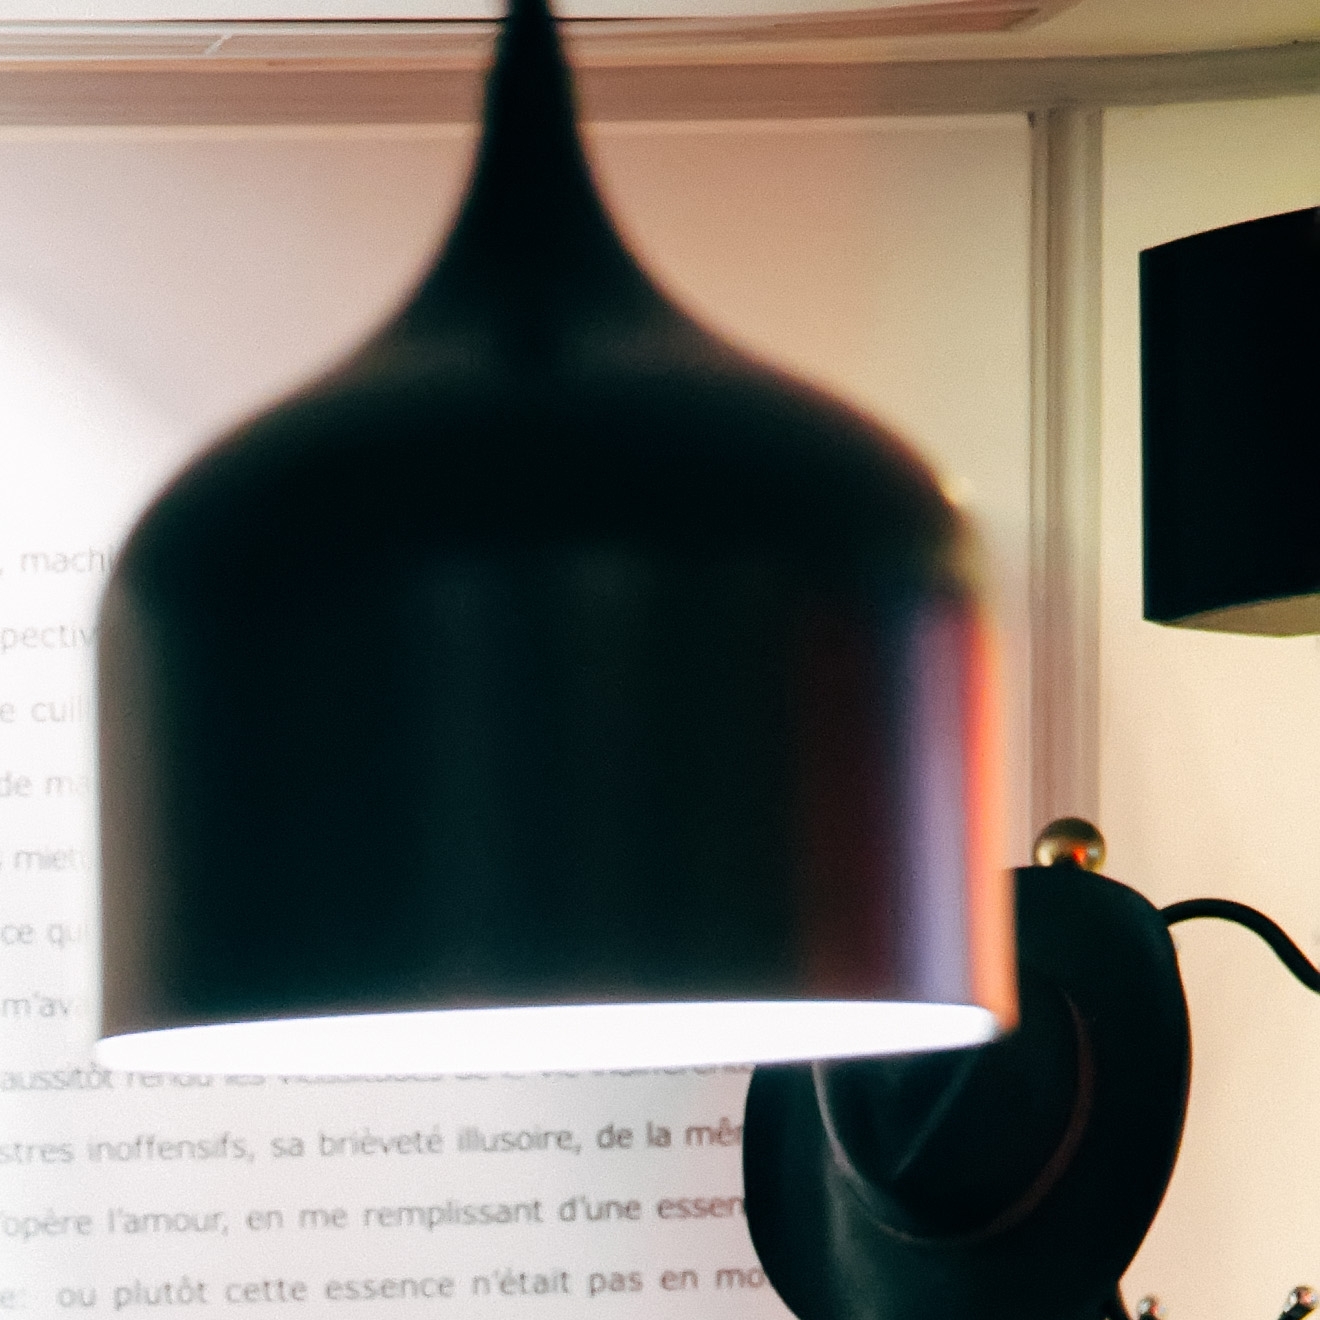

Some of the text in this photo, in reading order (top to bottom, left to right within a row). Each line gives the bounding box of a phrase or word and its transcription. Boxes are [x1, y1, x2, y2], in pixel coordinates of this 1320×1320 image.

[0, 922, 35, 946] ce
[87, 1132, 255, 1164] inoffensifs,
[271, 1135, 305, 1159] sa
[319, 1124, 443, 1157] brièveté
[457, 1125, 583, 1155] illusoire,
[596, 1123, 633, 1151] de
[646, 1120, 672, 1148] la
[108, 1208, 229, 1236] l'amour,
[245, 1209, 284, 1232] en
[299, 1206, 348, 1230] me
[364, 1198, 543, 1232] remplissant
[558, 1197, 642, 1223] d'une
[56, 1286, 98, 1309] ou
[113, 1275, 208, 1312] plutôt
[224, 1277, 308, 1305] cette
[325, 1275, 455, 1302] essence
[471, 1266, 569, 1297] n'était
[589, 1270, 643, 1299] pas
[660, 1267, 698, 1293] en
